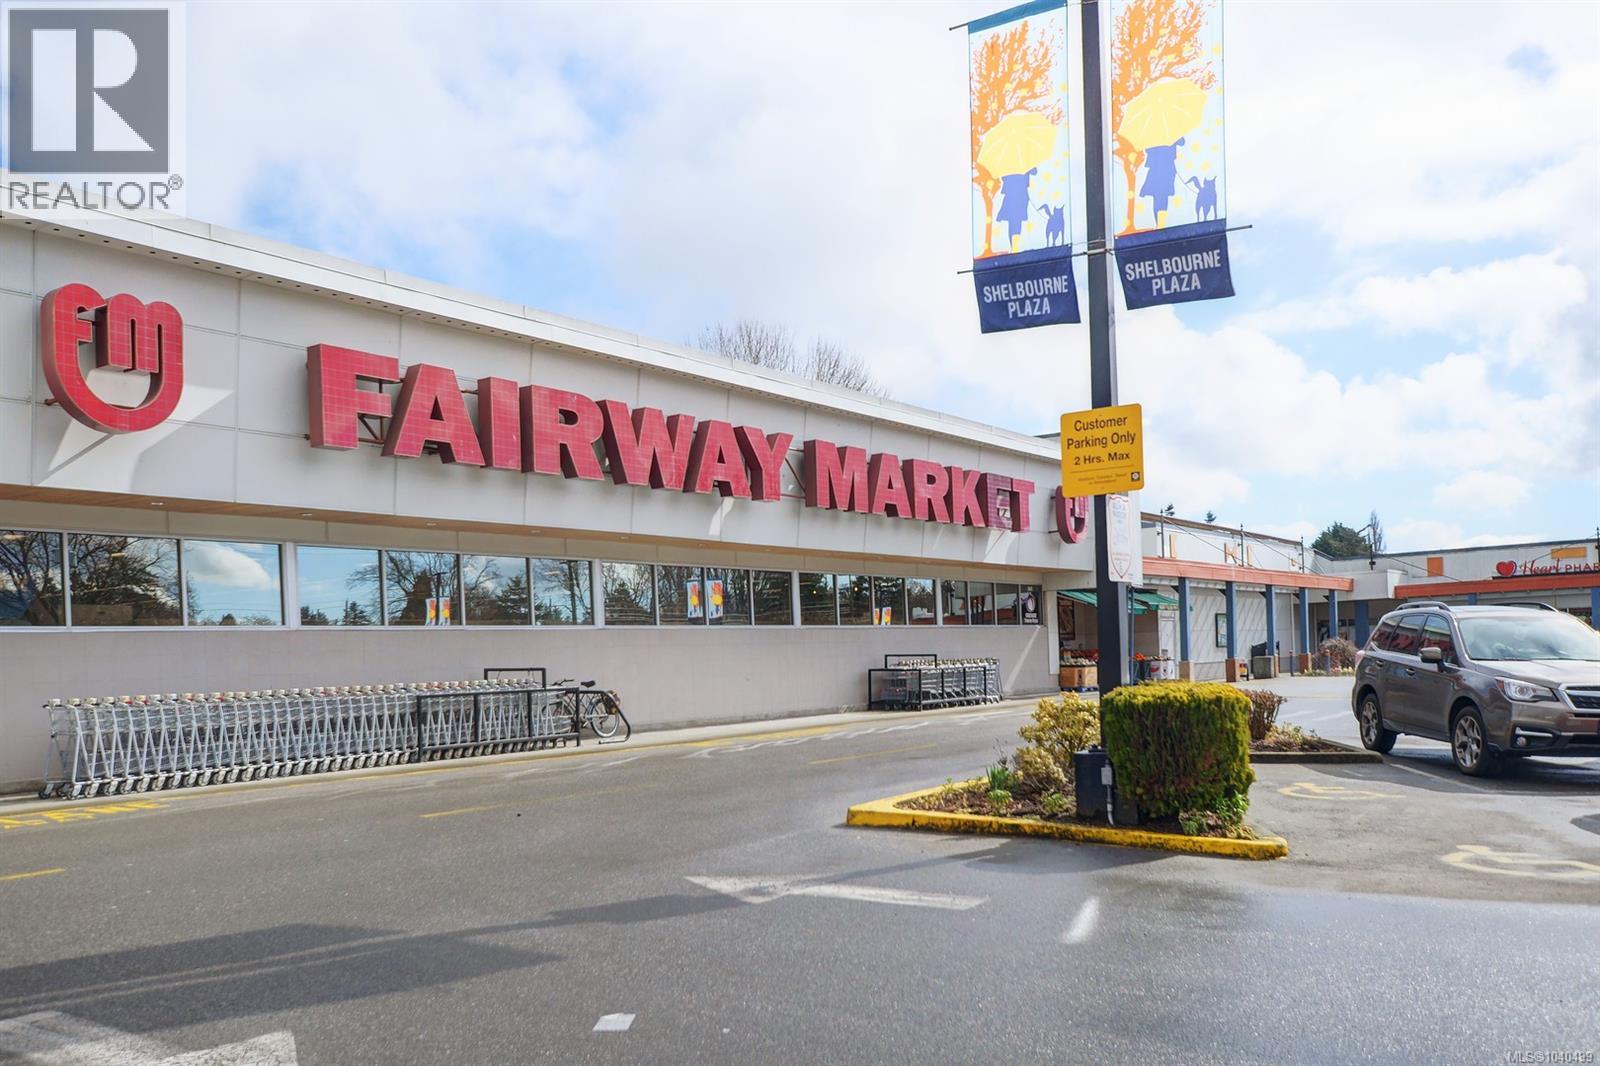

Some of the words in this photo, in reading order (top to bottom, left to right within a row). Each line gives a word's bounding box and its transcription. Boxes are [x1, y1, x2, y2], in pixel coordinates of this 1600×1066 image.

[1125, 249, 1221, 281] SHELBOURNE
[983, 275, 1069, 303] SHELBOURNE
[1152, 272, 1201, 296] PLAZA
[1008, 297, 1051, 319] PLAZA
[1074, 415, 1128, 432] Customer
[307, 343, 793, 502] FAIRWAY
[804, 439, 1035, 533] MARKET
[1066, 434, 1108, 450] Parking
[1111, 431, 1136, 446] Only
[1074, 456, 1081, 466] 2
[1083, 454, 1105, 465] Hrs.
[1108, 451, 1131, 462] Max
[1521, 558, 1561, 575] Heart
